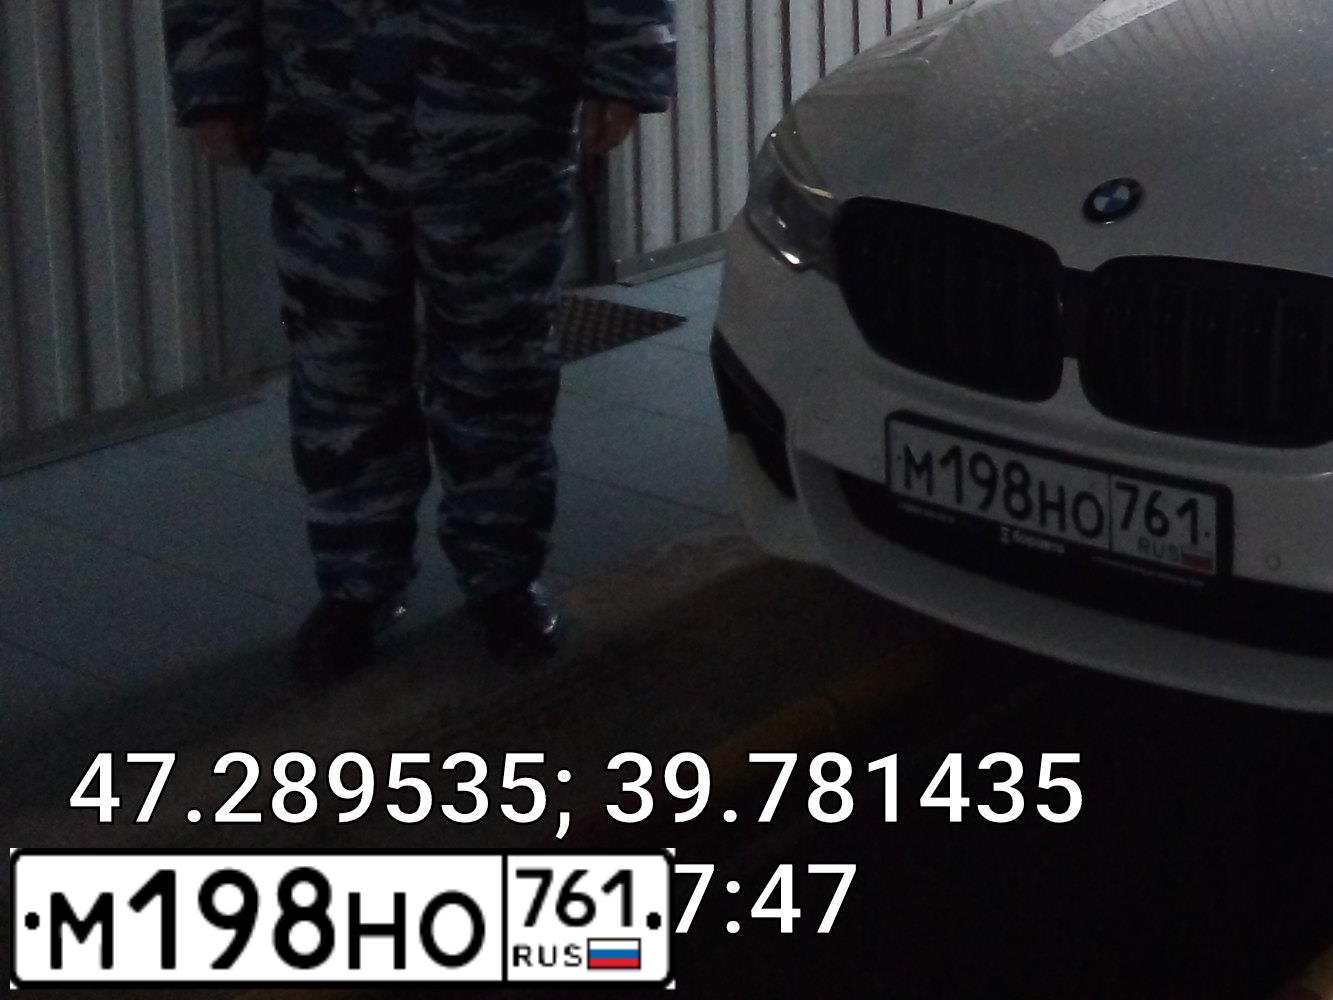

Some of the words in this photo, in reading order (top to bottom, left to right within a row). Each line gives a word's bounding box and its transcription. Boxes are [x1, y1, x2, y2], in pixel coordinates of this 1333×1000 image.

[904, 444, 1104, 538] М198НО
[1115, 481, 1201, 545] 761
[1138, 537, 1180, 562] RUS
